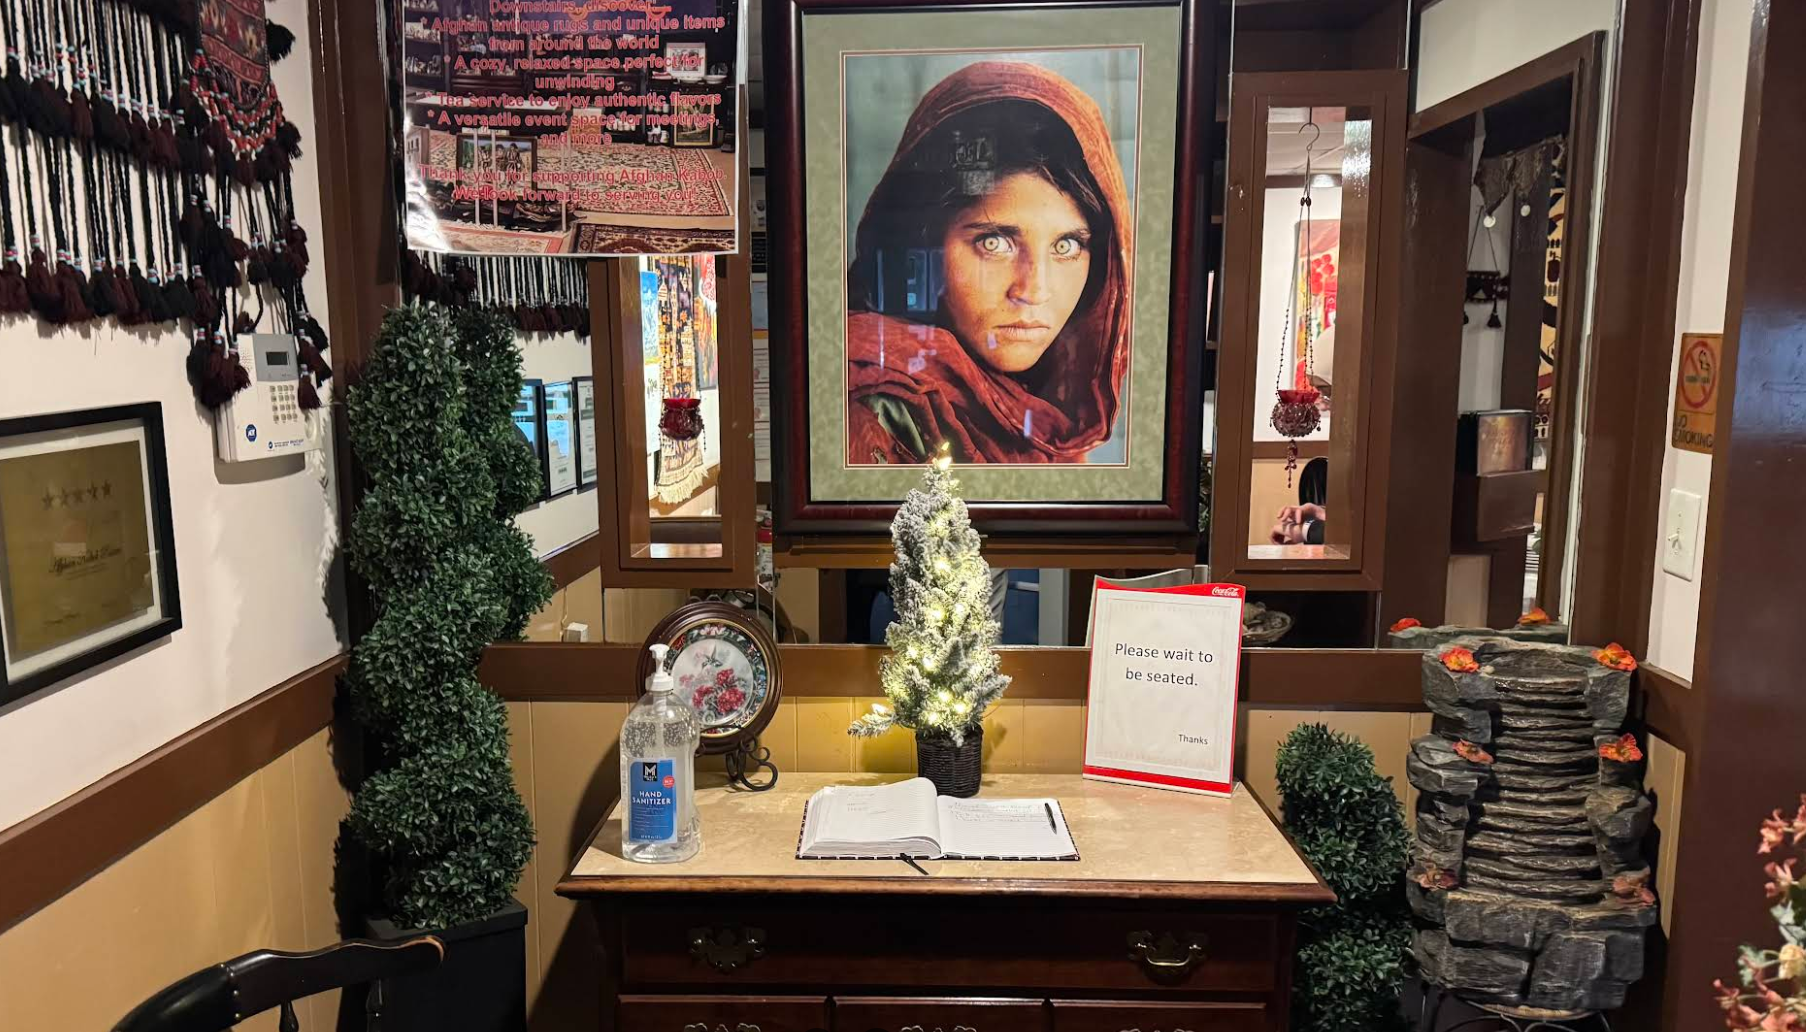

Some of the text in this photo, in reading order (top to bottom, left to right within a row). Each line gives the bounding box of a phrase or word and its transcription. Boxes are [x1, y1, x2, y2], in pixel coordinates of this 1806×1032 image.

[432, 14, 725, 34] Afghan antique rugs and unique items
[488, 35, 660, 51] from around the world
[454, 55, 467, 70] A
[513, 55, 571, 70] relaxed
[574, 57, 621, 72] space
[624, 53, 678, 71] perfect
[681, 53, 704, 67] for
[535, 74, 615, 90] unwinding
[437, 91, 722, 110] Tea service to enjoy authentic flavors
[438, 110, 721, 128] A versatile event space for meetings,
[540, 133, 613, 146] and more
[419, 164, 468, 181] Thank
[473, 169, 501, 184] you
[506, 168, 527, 182] for
[533, 169, 615, 185] supporting
[620, 168, 674, 184] Afghan
[485, 184, 517, 200] look
[523, 185, 580, 200] forward
[585, 187, 600, 201] to
[605, 188, 661, 204] serving
[1115, 643, 1213, 664] Please wait to
[1126, 667, 1198, 686] be seated.
[1178, 734, 1208, 745] Thanks
[632, 797, 671, 805] SANITIZER
